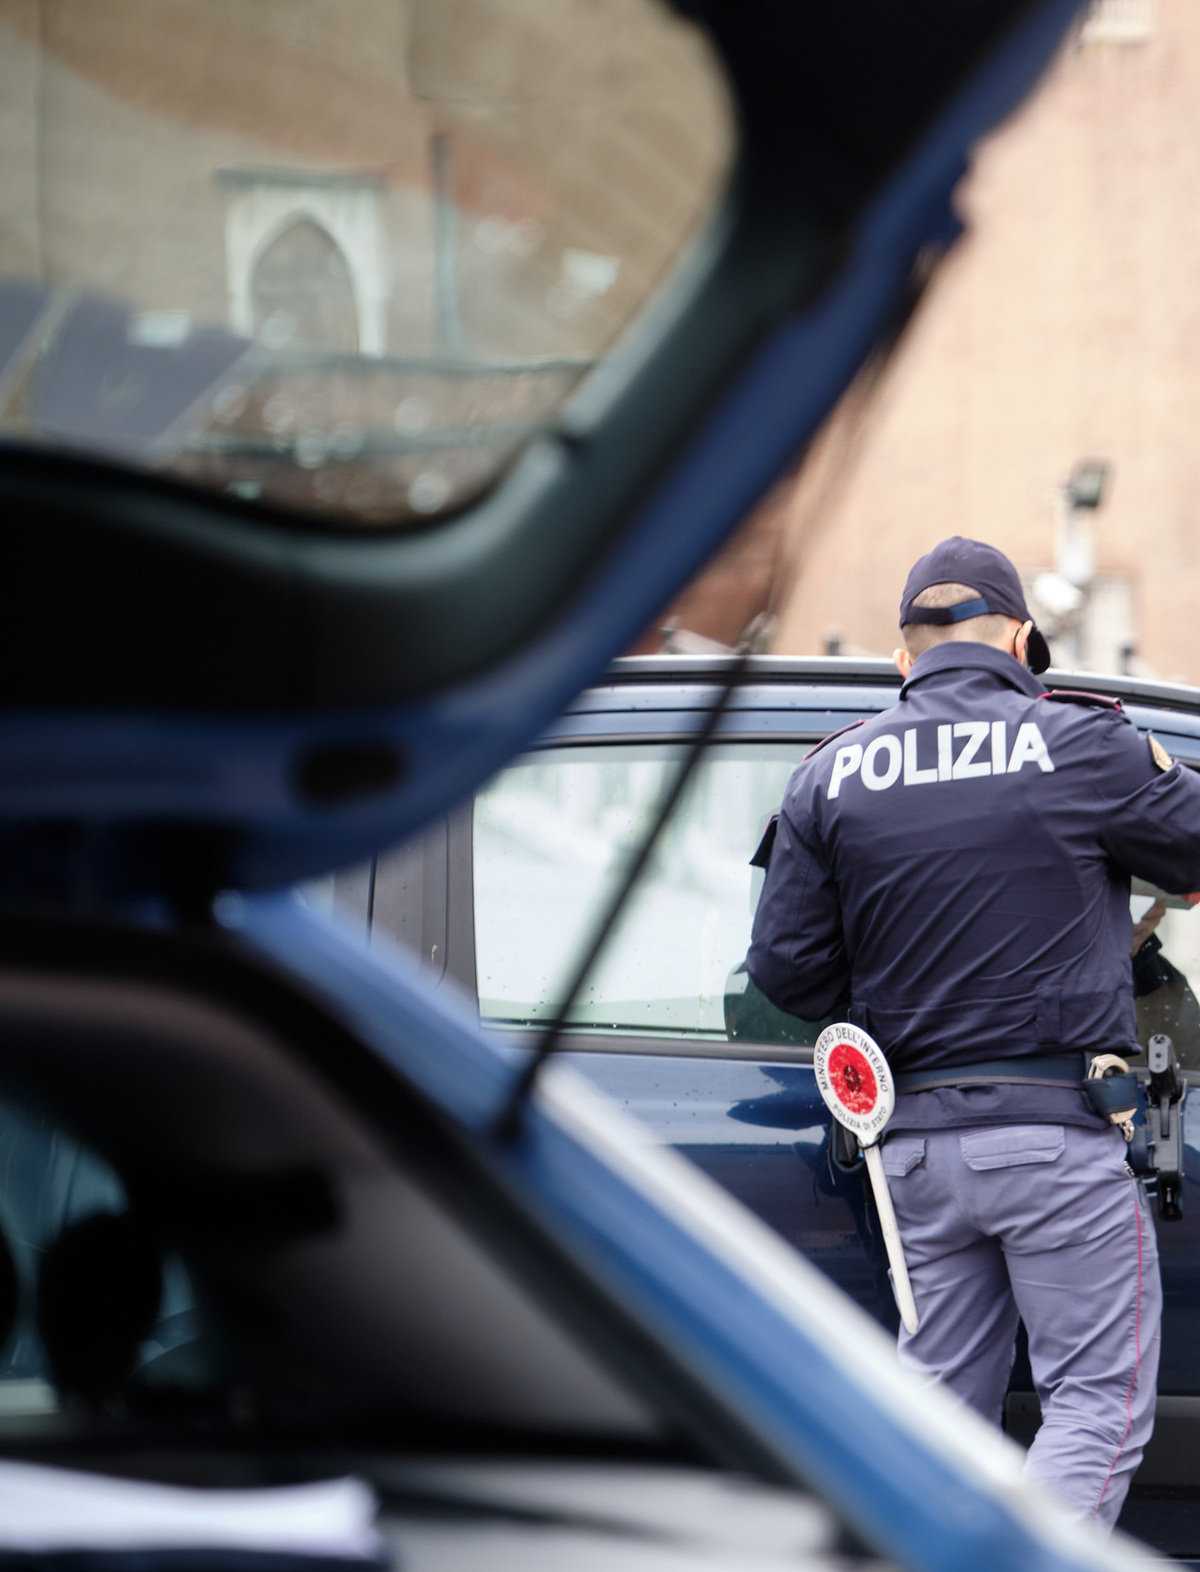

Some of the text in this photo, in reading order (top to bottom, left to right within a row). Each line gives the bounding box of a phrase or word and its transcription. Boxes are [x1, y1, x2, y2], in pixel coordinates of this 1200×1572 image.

[828, 721, 1055, 800] POLIZIA
[817, 1031, 834, 1090] MINISTERO
[833, 1103, 887, 1131] POLIZIA DI STATO
